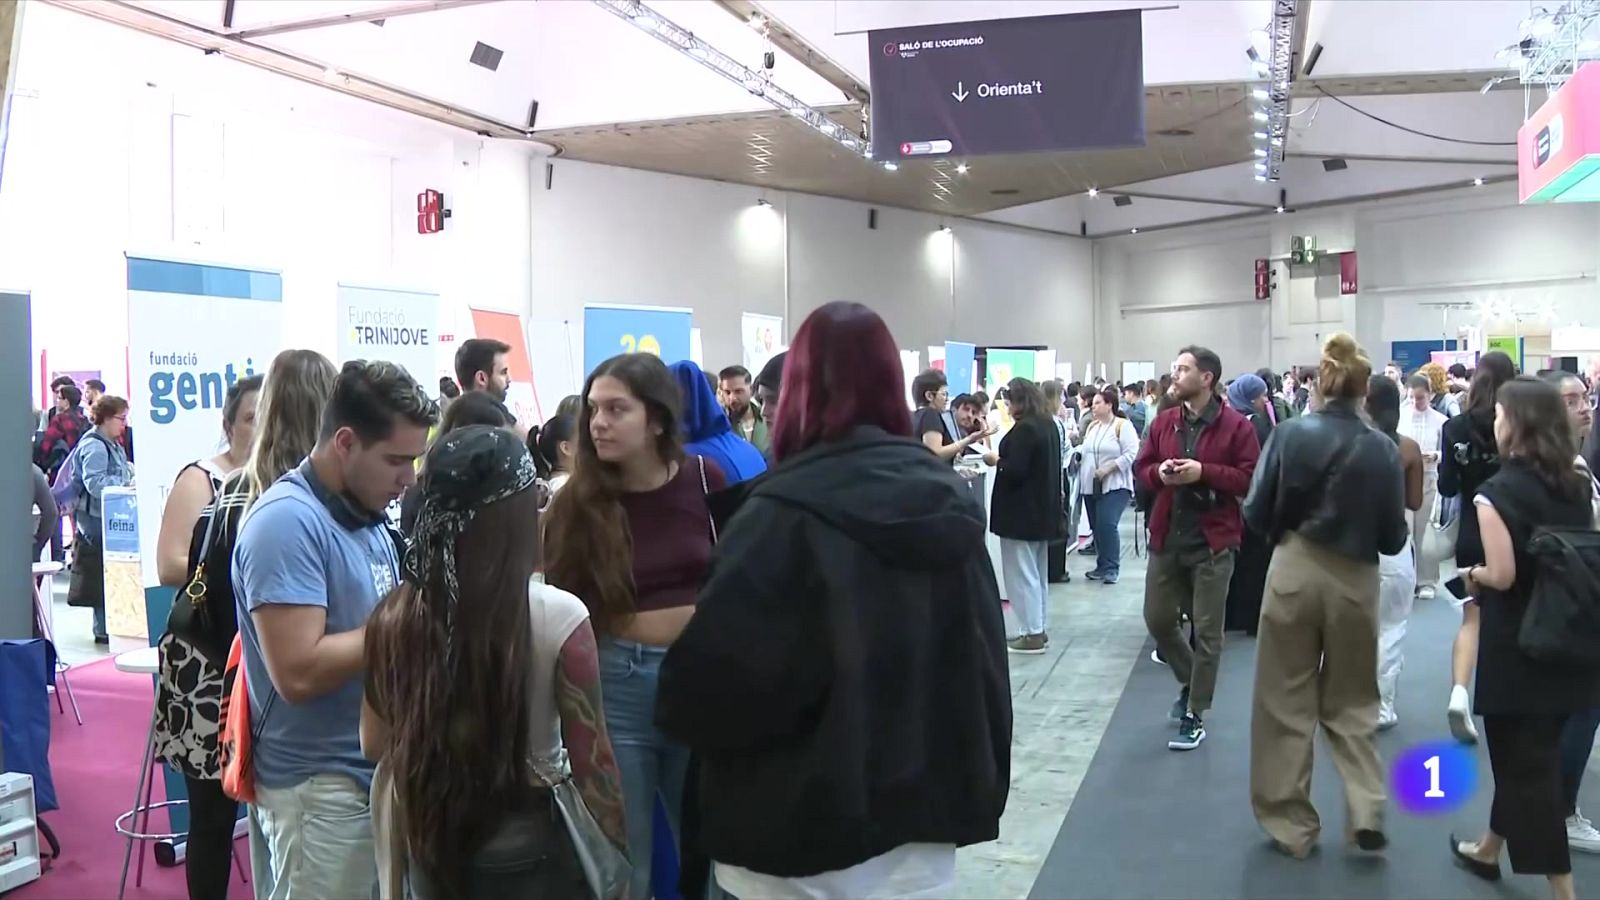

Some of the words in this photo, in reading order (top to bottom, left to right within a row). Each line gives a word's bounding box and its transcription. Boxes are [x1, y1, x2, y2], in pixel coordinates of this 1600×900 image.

[899, 41, 920, 51] SALÓ
[922, 41, 933, 49] DE
[935, 36, 984, 48] L'OCUPACIÓ
[348, 305, 406, 325] Fundació
[355, 326, 429, 345] TRINIJOVE
[149, 351, 198, 366] fundació
[109, 519, 135, 532] feina
